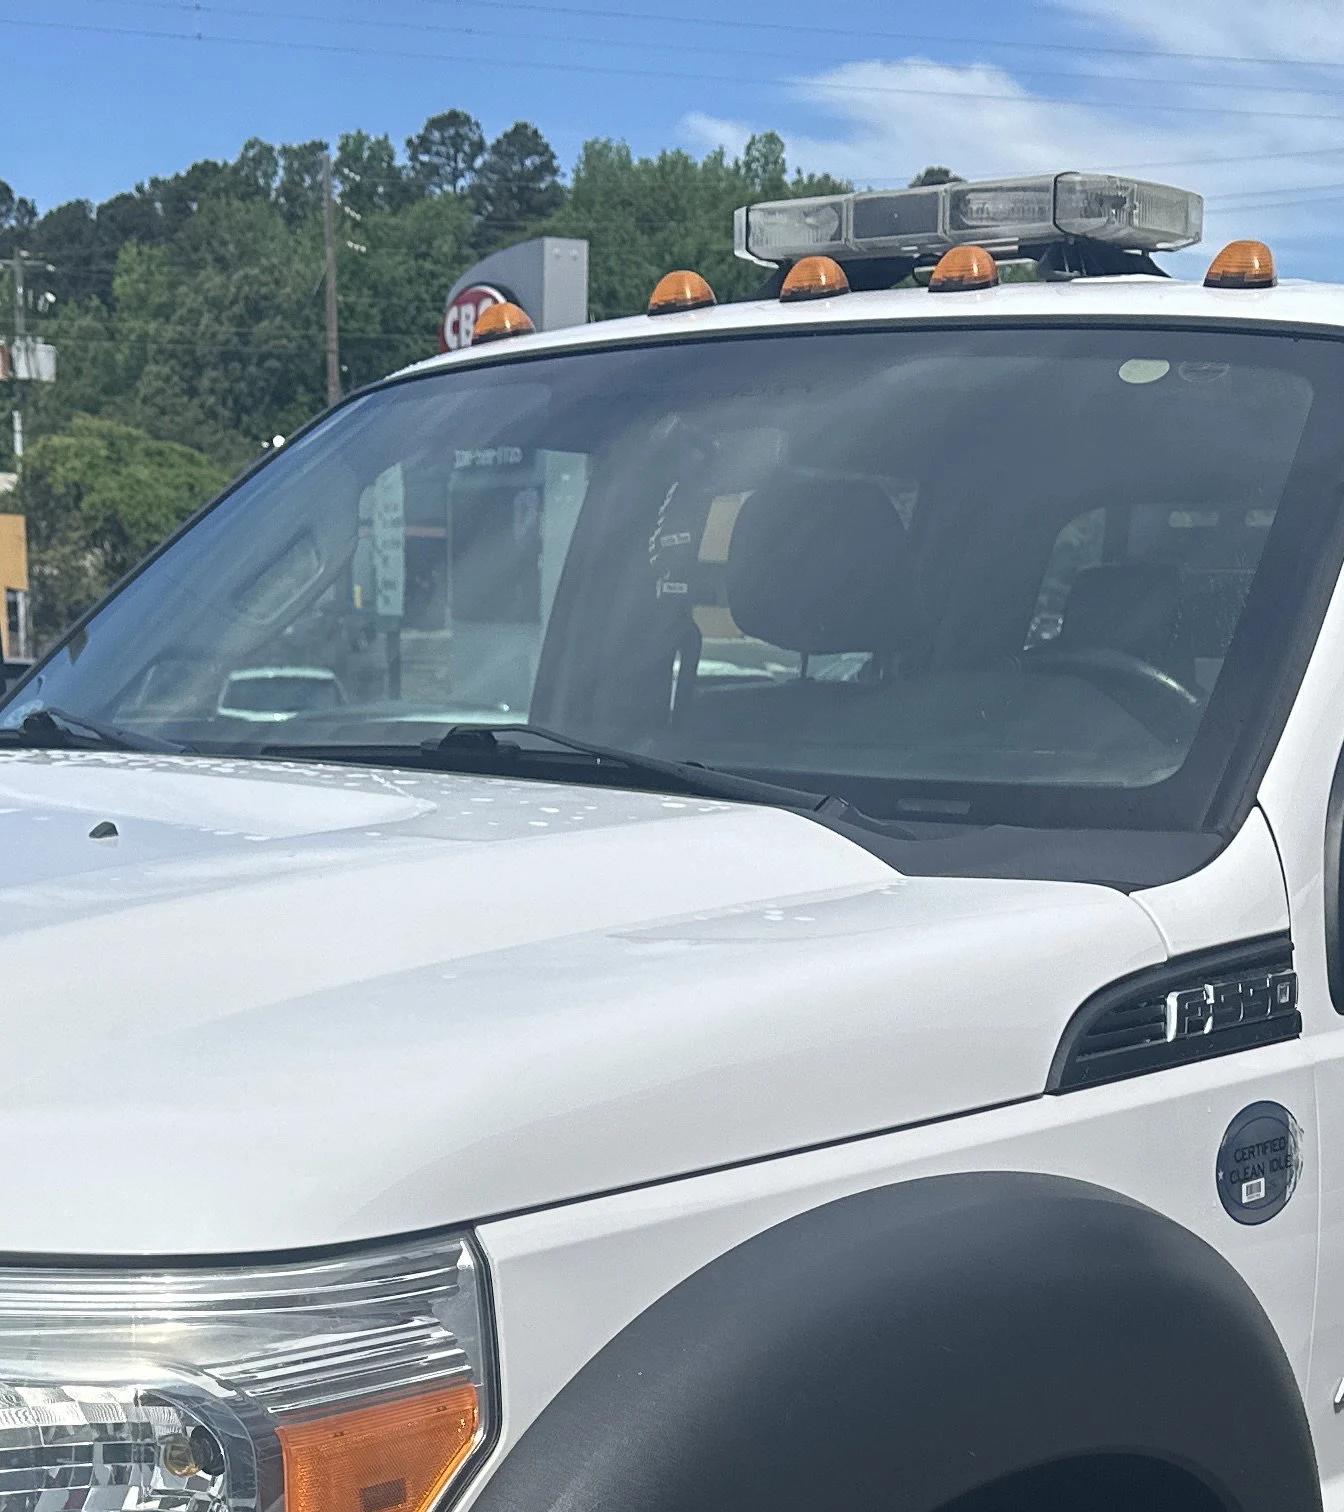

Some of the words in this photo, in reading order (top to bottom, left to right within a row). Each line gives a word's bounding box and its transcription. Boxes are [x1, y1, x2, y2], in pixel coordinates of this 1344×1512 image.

[444, 297, 493, 350] CB
[1234, 1136, 1287, 1164] CERTIFIED
[1229, 1162, 1265, 1185] CLEAN
[1268, 1153, 1294, 1173] IDLE
